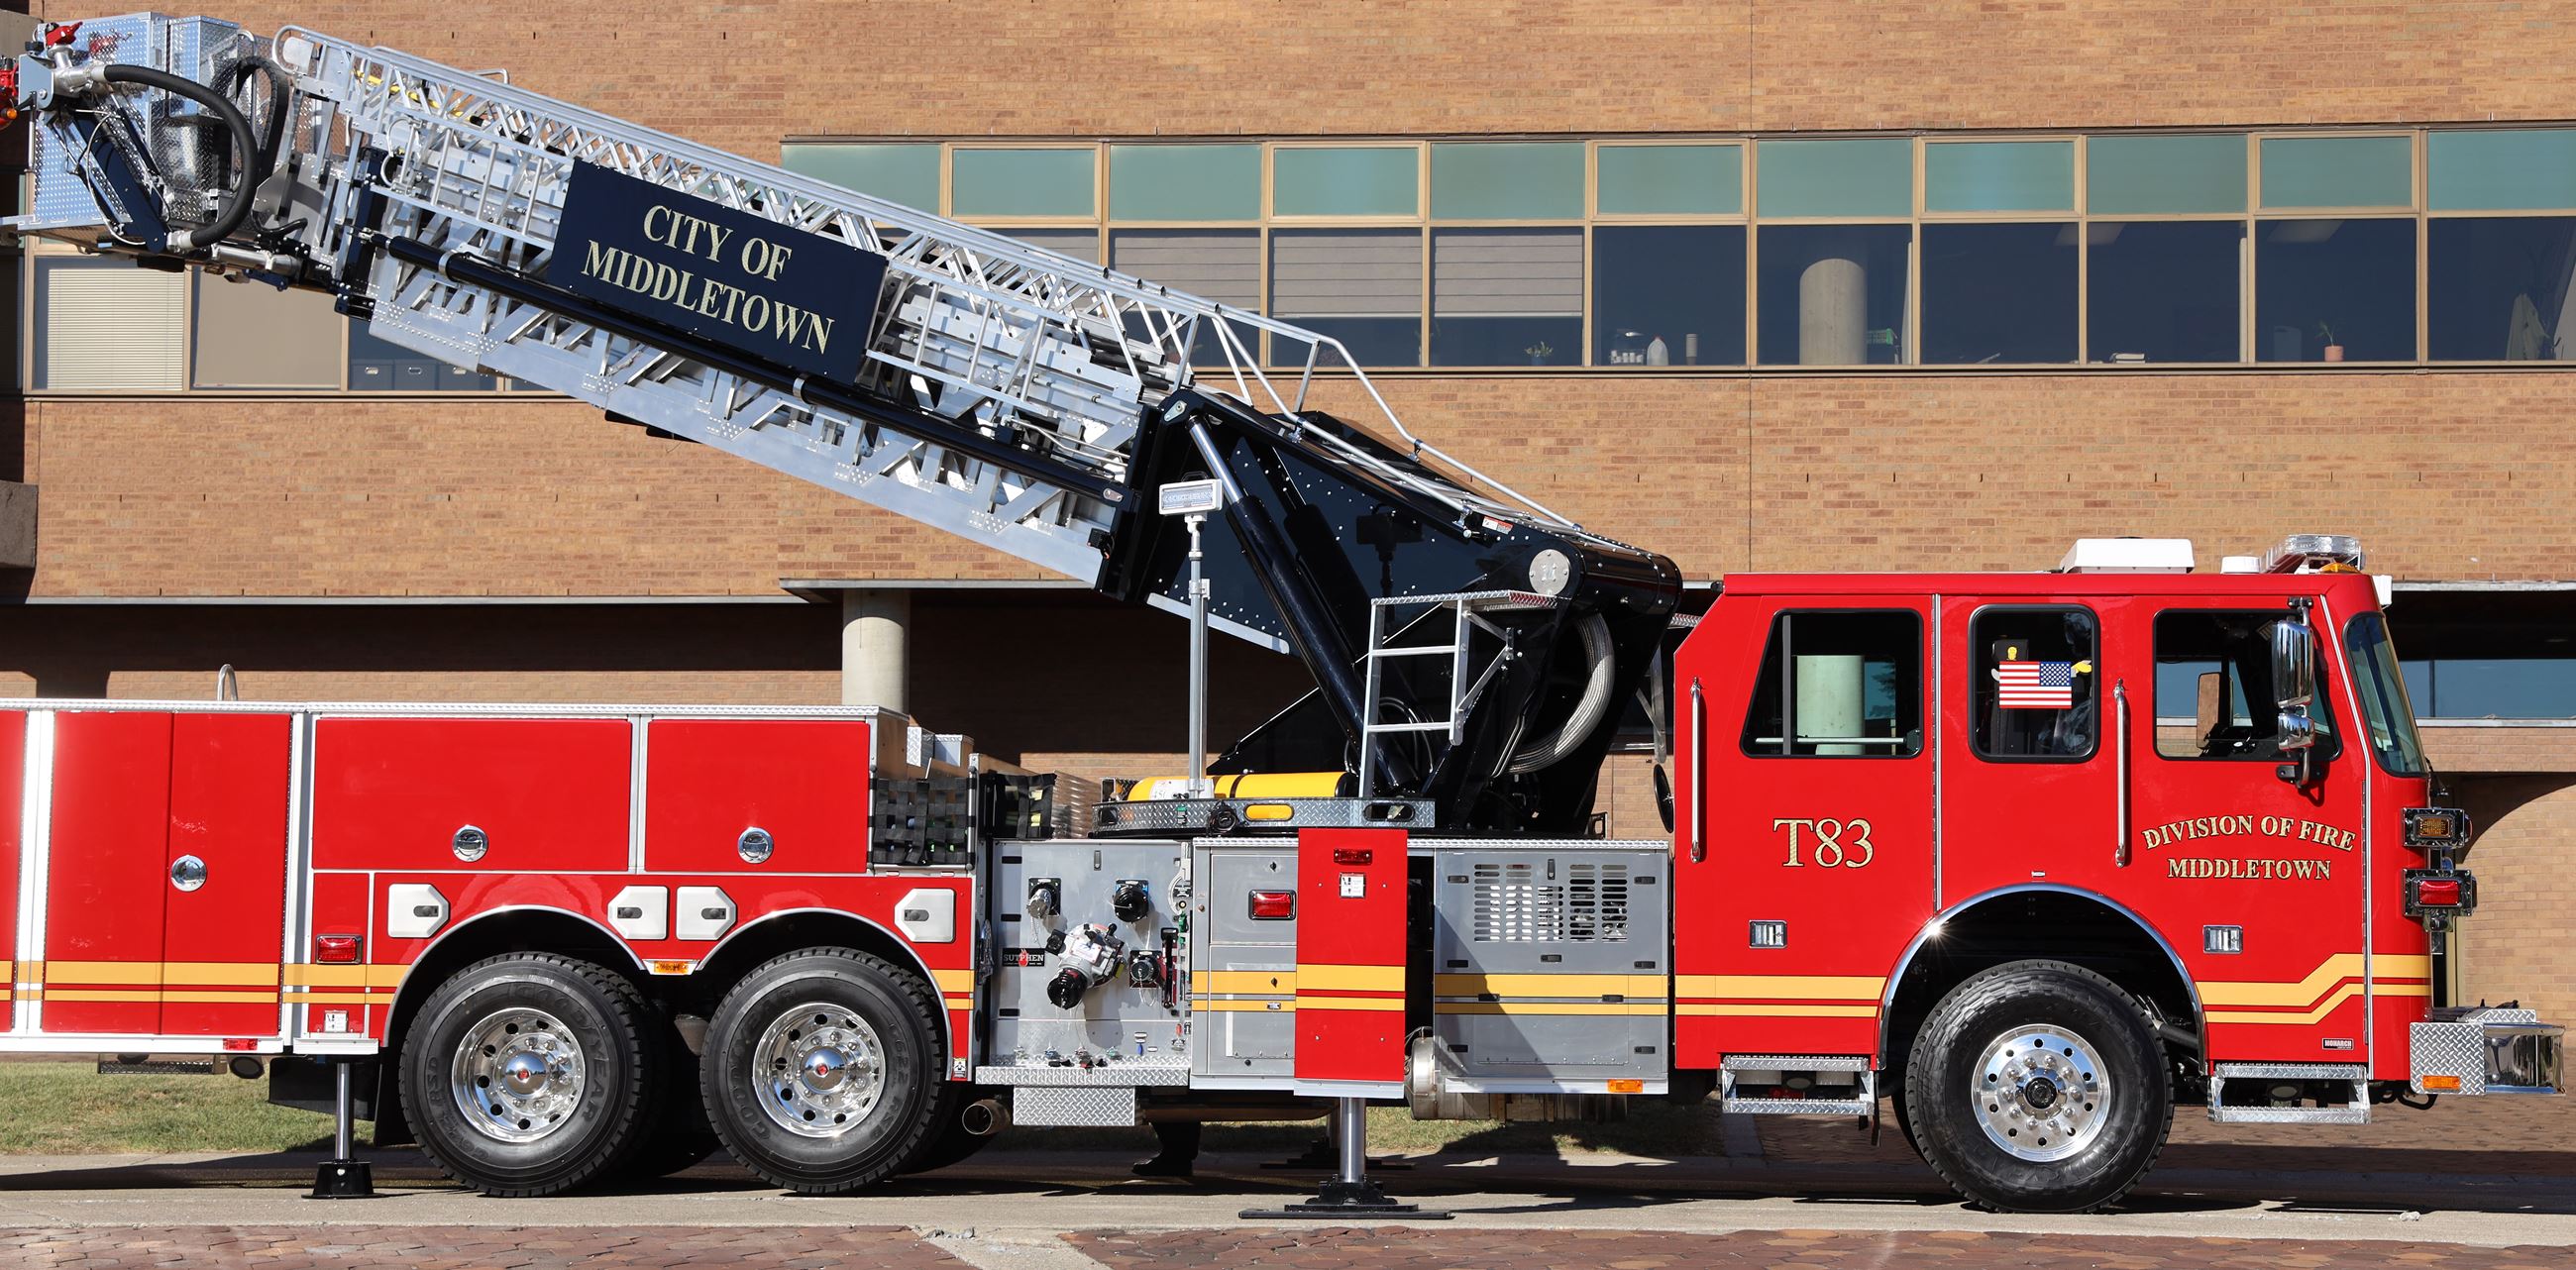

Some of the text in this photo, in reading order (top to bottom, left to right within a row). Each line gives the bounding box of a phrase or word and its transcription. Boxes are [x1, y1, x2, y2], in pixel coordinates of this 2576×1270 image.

[644, 204, 793, 281] CITY OF
[581, 240, 835, 355] MIDDLETOWN
[1772, 817, 1875, 868] T83
[2141, 814, 2356, 852] DIVISION OF FIRE
[2167, 858, 2331, 881] MIDDLETOWN
